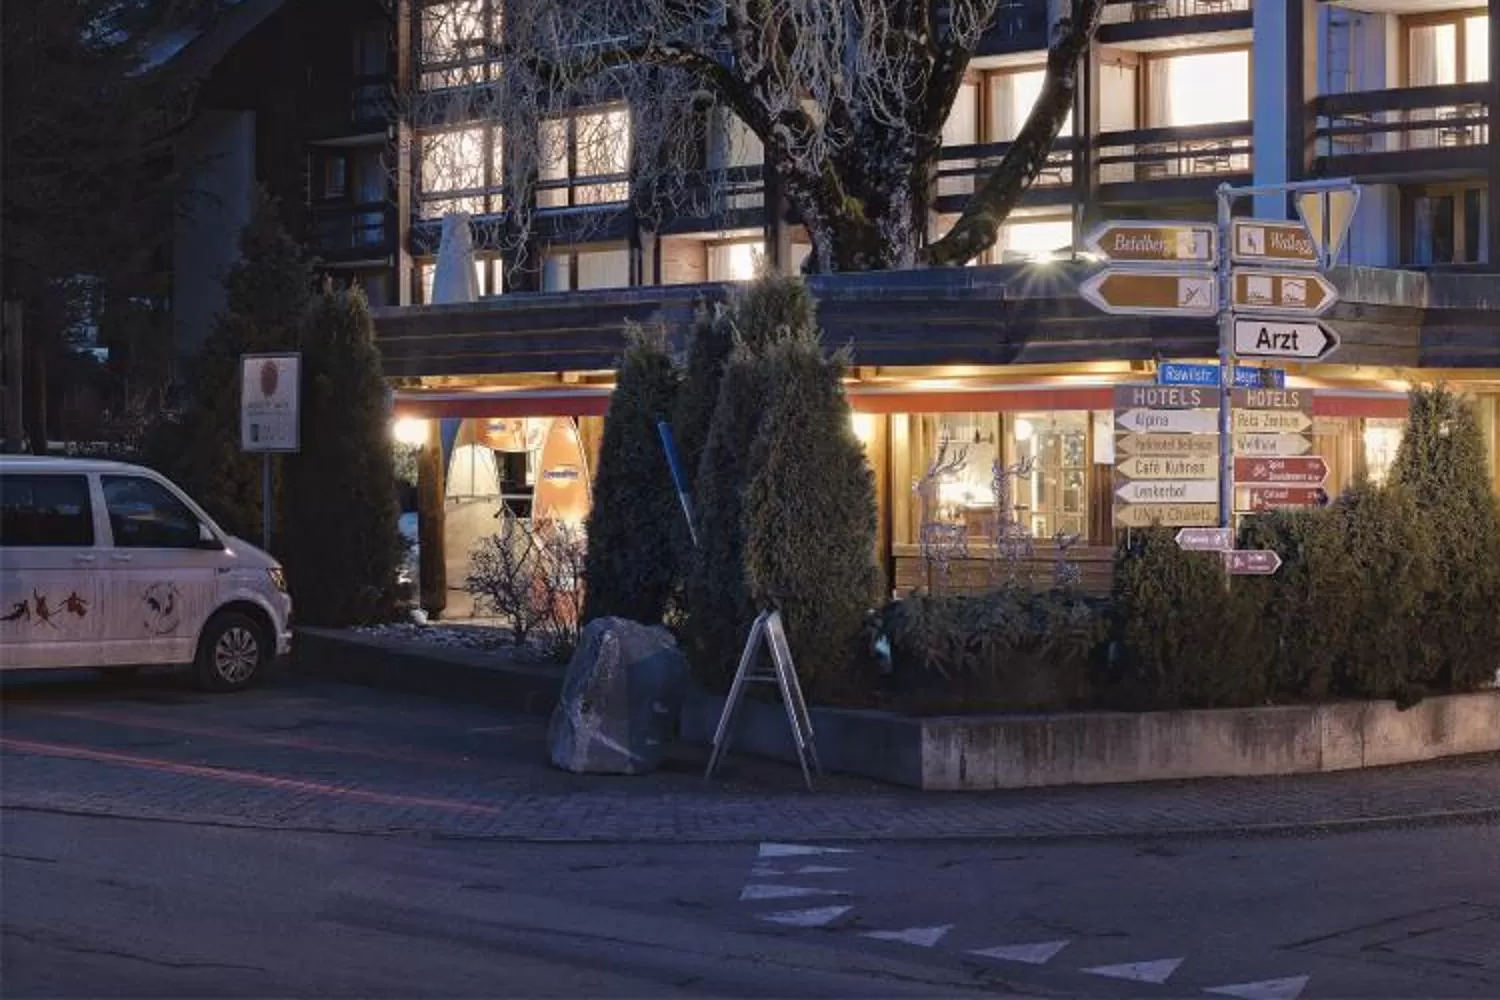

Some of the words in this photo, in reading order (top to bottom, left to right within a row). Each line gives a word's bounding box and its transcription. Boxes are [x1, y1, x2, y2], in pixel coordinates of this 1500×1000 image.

[1255, 327, 1299, 350] Arzt
[1133, 388, 1201, 406] HOTELS
[1247, 389, 1299, 407] HOTELS
[1135, 412, 1169, 428] Alpina
